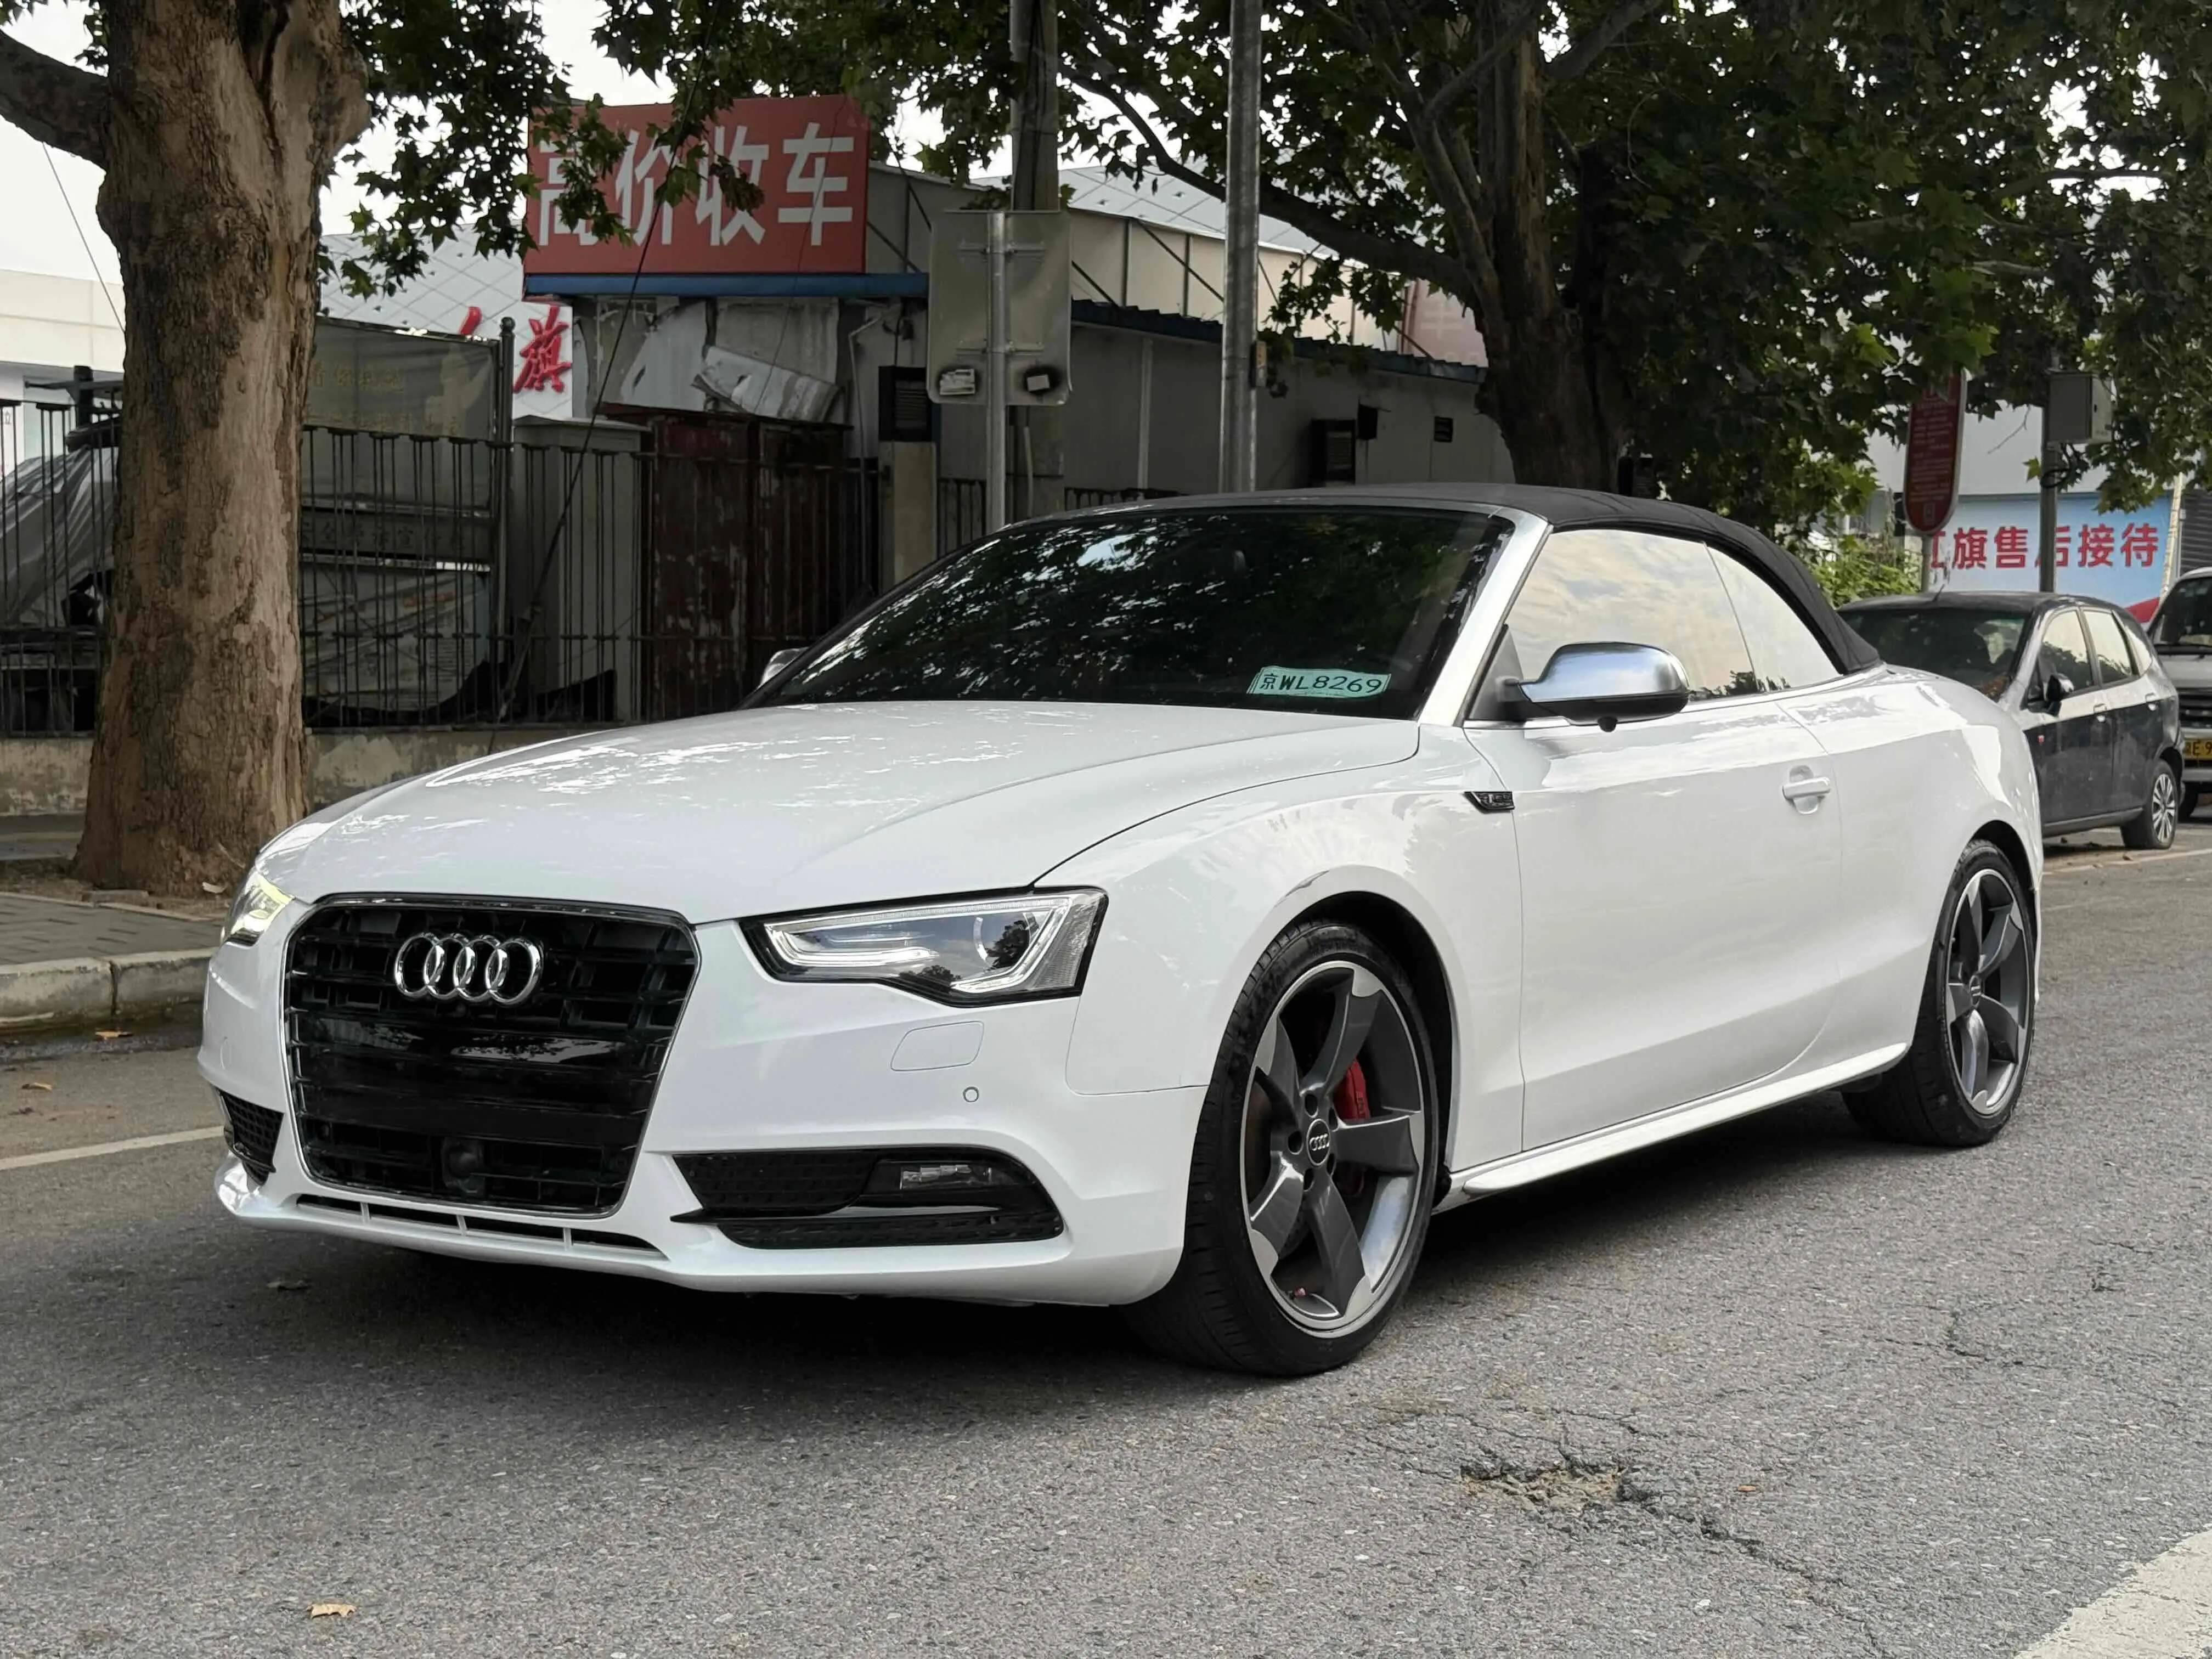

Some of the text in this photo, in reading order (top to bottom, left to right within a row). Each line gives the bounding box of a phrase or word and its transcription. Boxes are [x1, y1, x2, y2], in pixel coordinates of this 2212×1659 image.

[538, 122, 855, 247] 高价收车
[1260, 673, 1383, 693] 京WL8269
